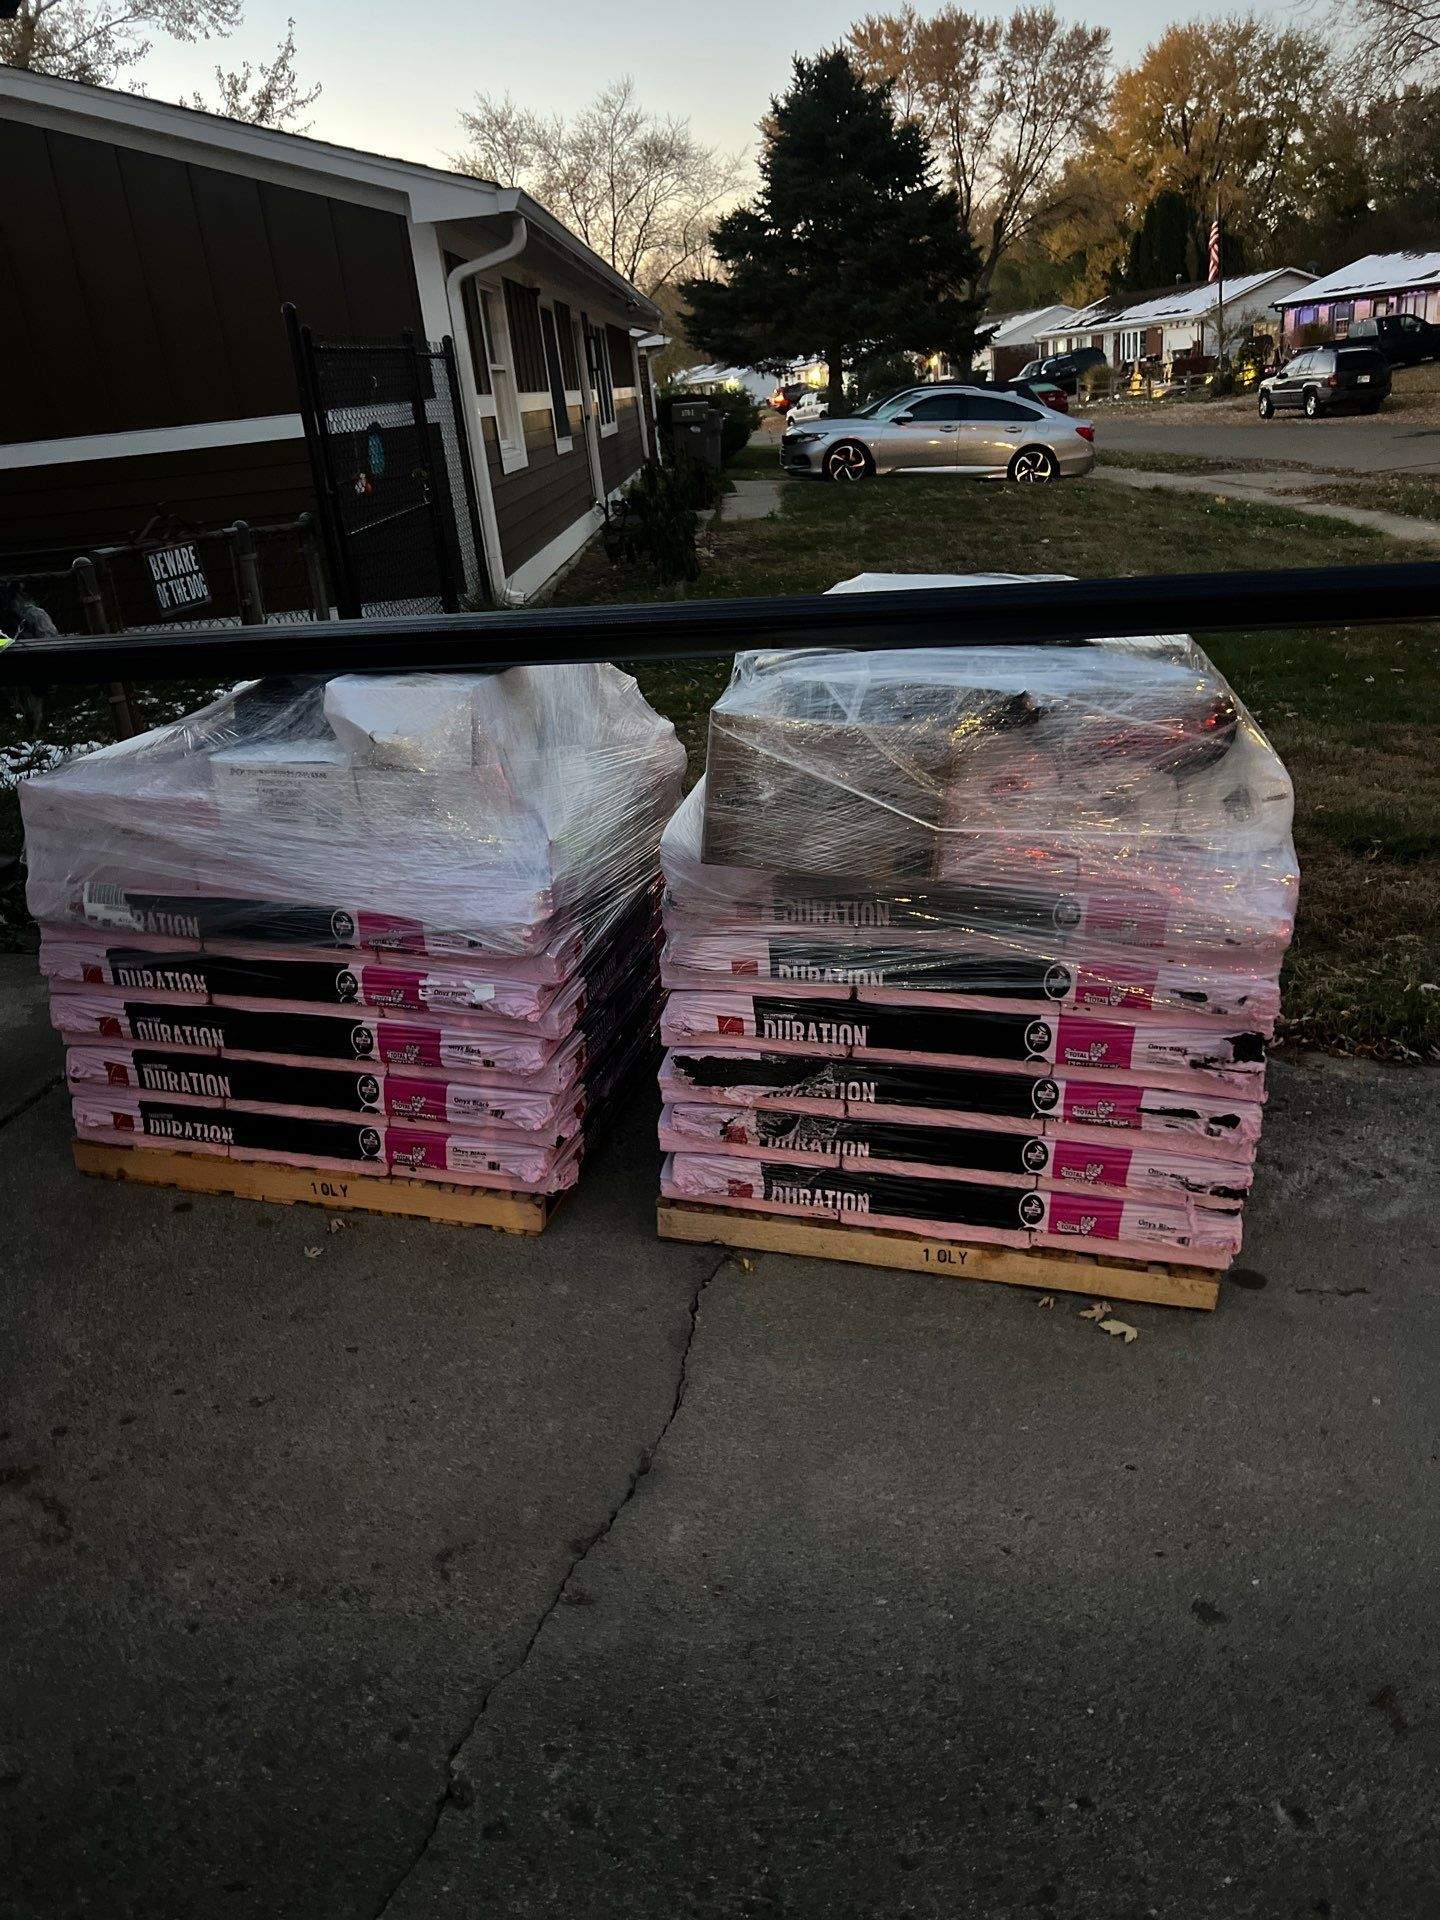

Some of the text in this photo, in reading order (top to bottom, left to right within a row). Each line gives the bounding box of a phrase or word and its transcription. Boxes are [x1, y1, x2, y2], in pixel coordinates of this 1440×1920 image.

[148, 545, 199, 580] BEWARE
[156, 572, 209, 608] OF THE DOG
[118, 968, 209, 994] DURATION
[779, 964, 885, 988] DURATION
[136, 1021, 226, 1049] DURATION
[763, 1019, 868, 1048] DURATION
[1068, 1051, 1088, 1059] TOTAL
[142, 1067, 232, 1099] DURATION
[453, 1097, 490, 1108] Onyx Black
[1076, 1109, 1095, 1117] TOTAL
[149, 1118, 235, 1146] DURATION
[310, 1182, 349, 1198] 1 OLY
[771, 1186, 870, 1213] DURATION
[923, 1248, 968, 1265] 1 OLY
